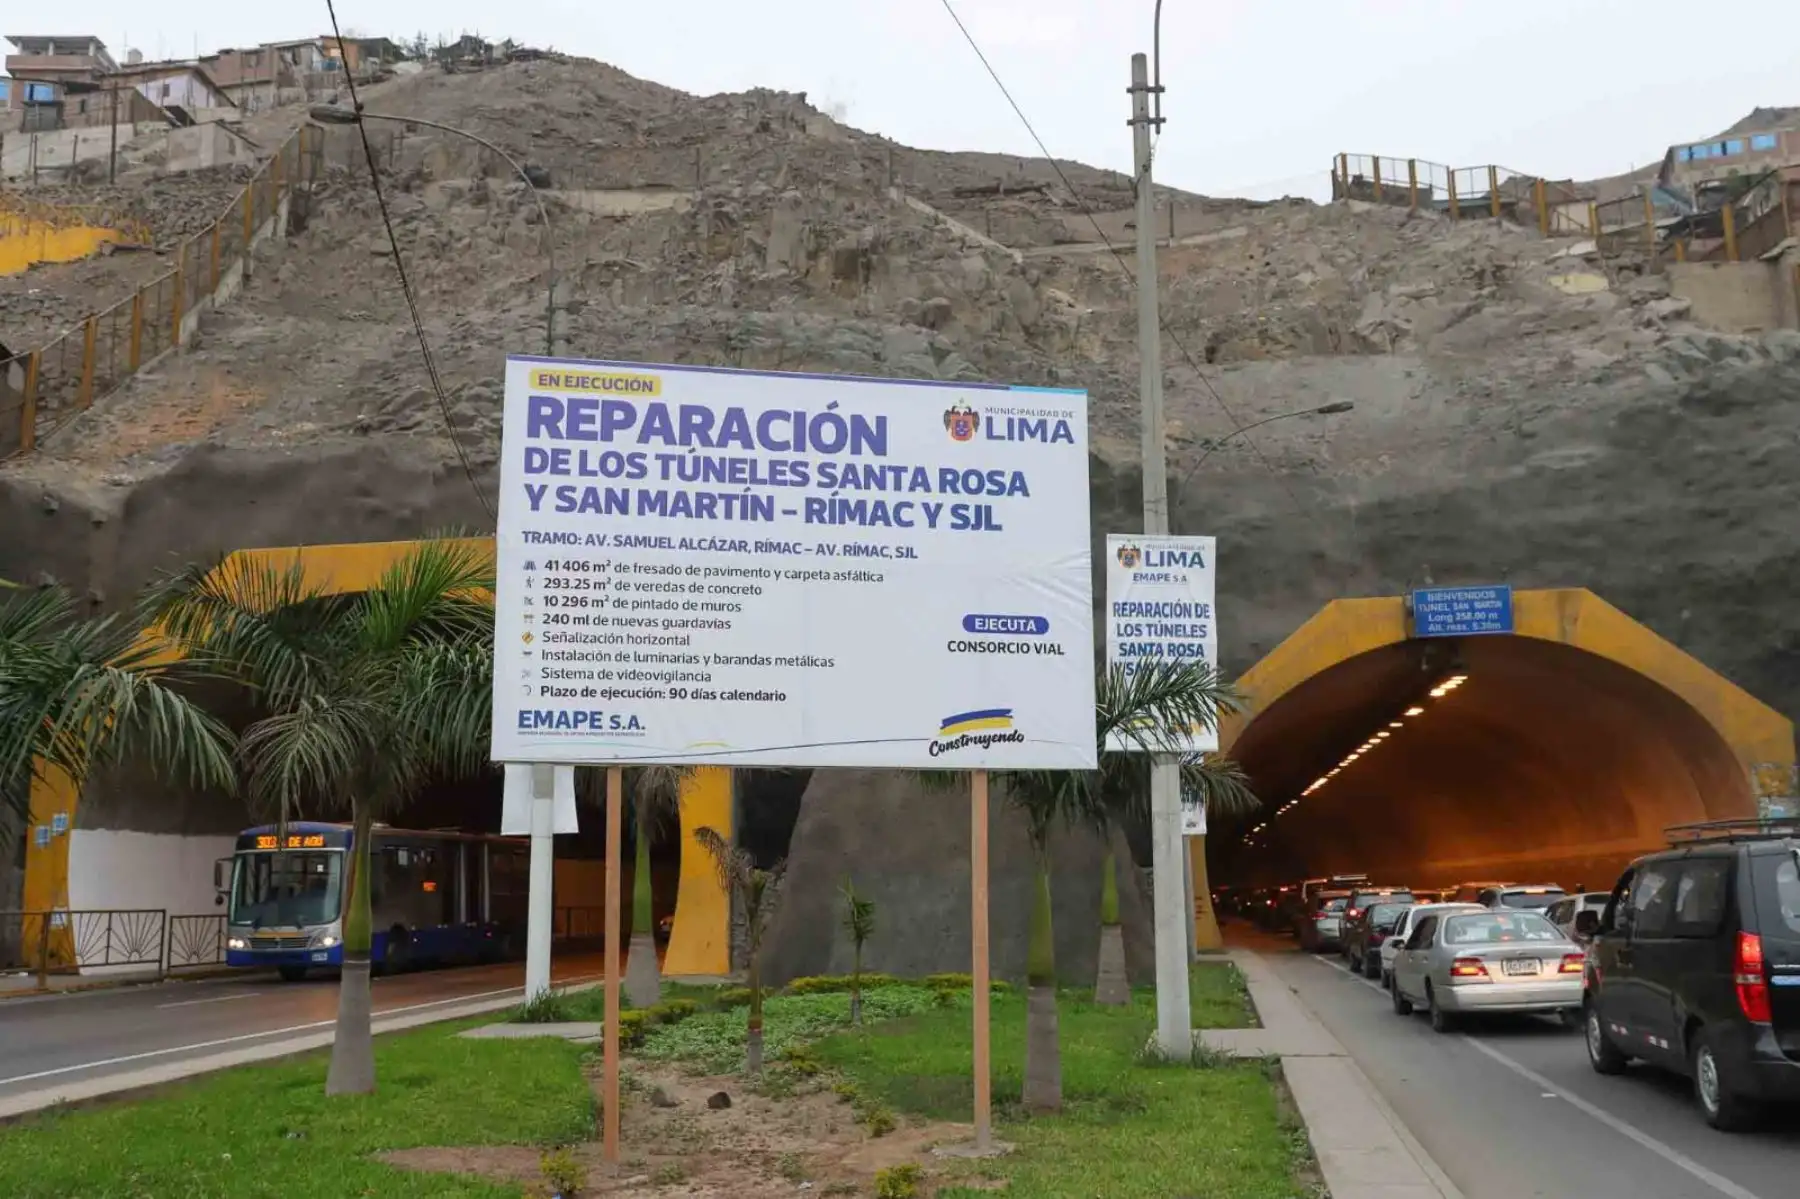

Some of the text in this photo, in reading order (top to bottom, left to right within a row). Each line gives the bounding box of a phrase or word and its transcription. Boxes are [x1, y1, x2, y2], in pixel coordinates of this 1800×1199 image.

[538, 374, 653, 392] EN EJECUCIÓN
[985, 406, 1058, 417] MUNICIPALIDAD
[527, 396, 887, 456] REPARACIÓN
[986, 416, 1075, 444] LIMA
[524, 447, 1030, 497] DE LOS TÚNELES SANTA ROSA
[524, 484, 548, 511] Y
[555, 485, 630, 515] SAN
[637, 487, 774, 521] MARTÍN
[804, 491, 914, 527] RÍMAC
[922, 502, 943, 528] Y
[951, 503, 1002, 531] SJL
[522, 531, 582, 546] TRAMO:
[585, 533, 610, 547] AV.
[613, 535, 675, 550] SAMUEL
[679, 535, 751, 554] ALCÁZAR,
[754, 537, 800, 554] RÍMAC
[816, 543, 840, 556] AV.
[843, 541, 892, 560] RÍMAC,
[895, 546, 918, 559] SJL
[1145, 551, 1205, 568] LIMA
[562, 560, 590, 572] 406
[614, 563, 630, 573] de
[633, 562, 682, 575] fresado
[685, 565, 701, 576] de
[703, 566, 770, 578] pavimento
[774, 570, 781, 580] y
[784, 569, 830, 582] carpeta
[833, 569, 884, 582] asfáltica
[1133, 573, 1171, 581] EMAPE
[544, 578, 590, 590] 293.25
[614, 580, 630, 592] de
[633, 581, 685, 593] veredas
[688, 582, 705, 594] de
[708, 585, 762, 596] concreto
[1427, 590, 1496, 602] BIENVENIDOS
[561, 596, 588, 608] 296
[612, 597, 629, 609] de
[631, 598, 679, 611] pintado
[682, 600, 698, 611] de
[701, 602, 742, 612] muros
[1113, 599, 1210, 619] REPARACIÓN DE
[542, 613, 731, 630] 240 ml de nuevas guardavías
[975, 618, 1036, 631] EJECUTA
[1117, 620, 1207, 638] LOS TÚNELES
[542, 631, 690, 646] Señalización horizontal
[947, 640, 1065, 655] CONSORCIO VIAL
[541, 649, 834, 668] Instalación de luminarias y barandas metálicas
[1119, 642, 1204, 657] SANTA ROSA
[541, 668, 712, 684] Sistema de videovigilancia
[540, 686, 786, 702] Plazo de ejecución: 90 días calendario
[518, 710, 646, 731] EMAPE S.A.
[929, 729, 1024, 757] Construyendo
